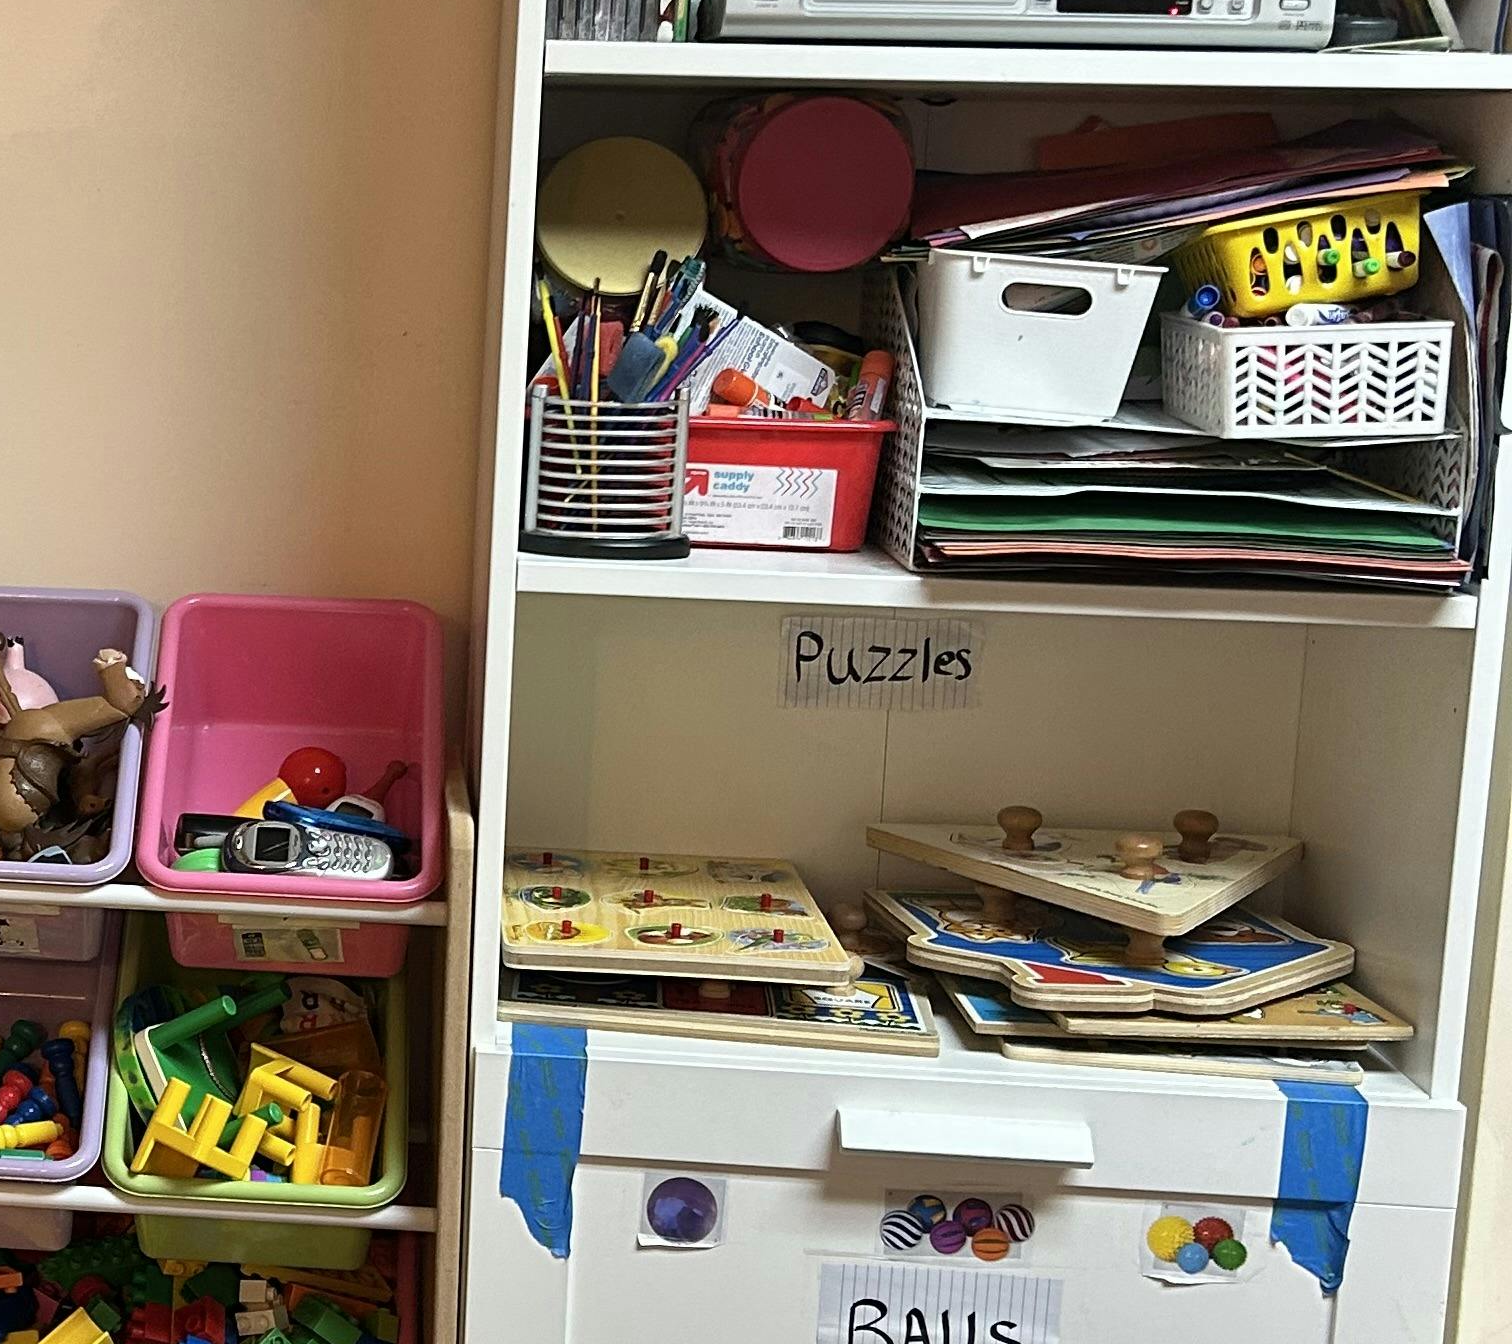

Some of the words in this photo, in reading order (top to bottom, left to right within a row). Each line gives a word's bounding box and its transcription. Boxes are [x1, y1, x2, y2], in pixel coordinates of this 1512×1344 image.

[713, 471, 755, 482] supply
[712, 481, 750, 493] caddy
[795, 630, 973, 685] Puzzles
